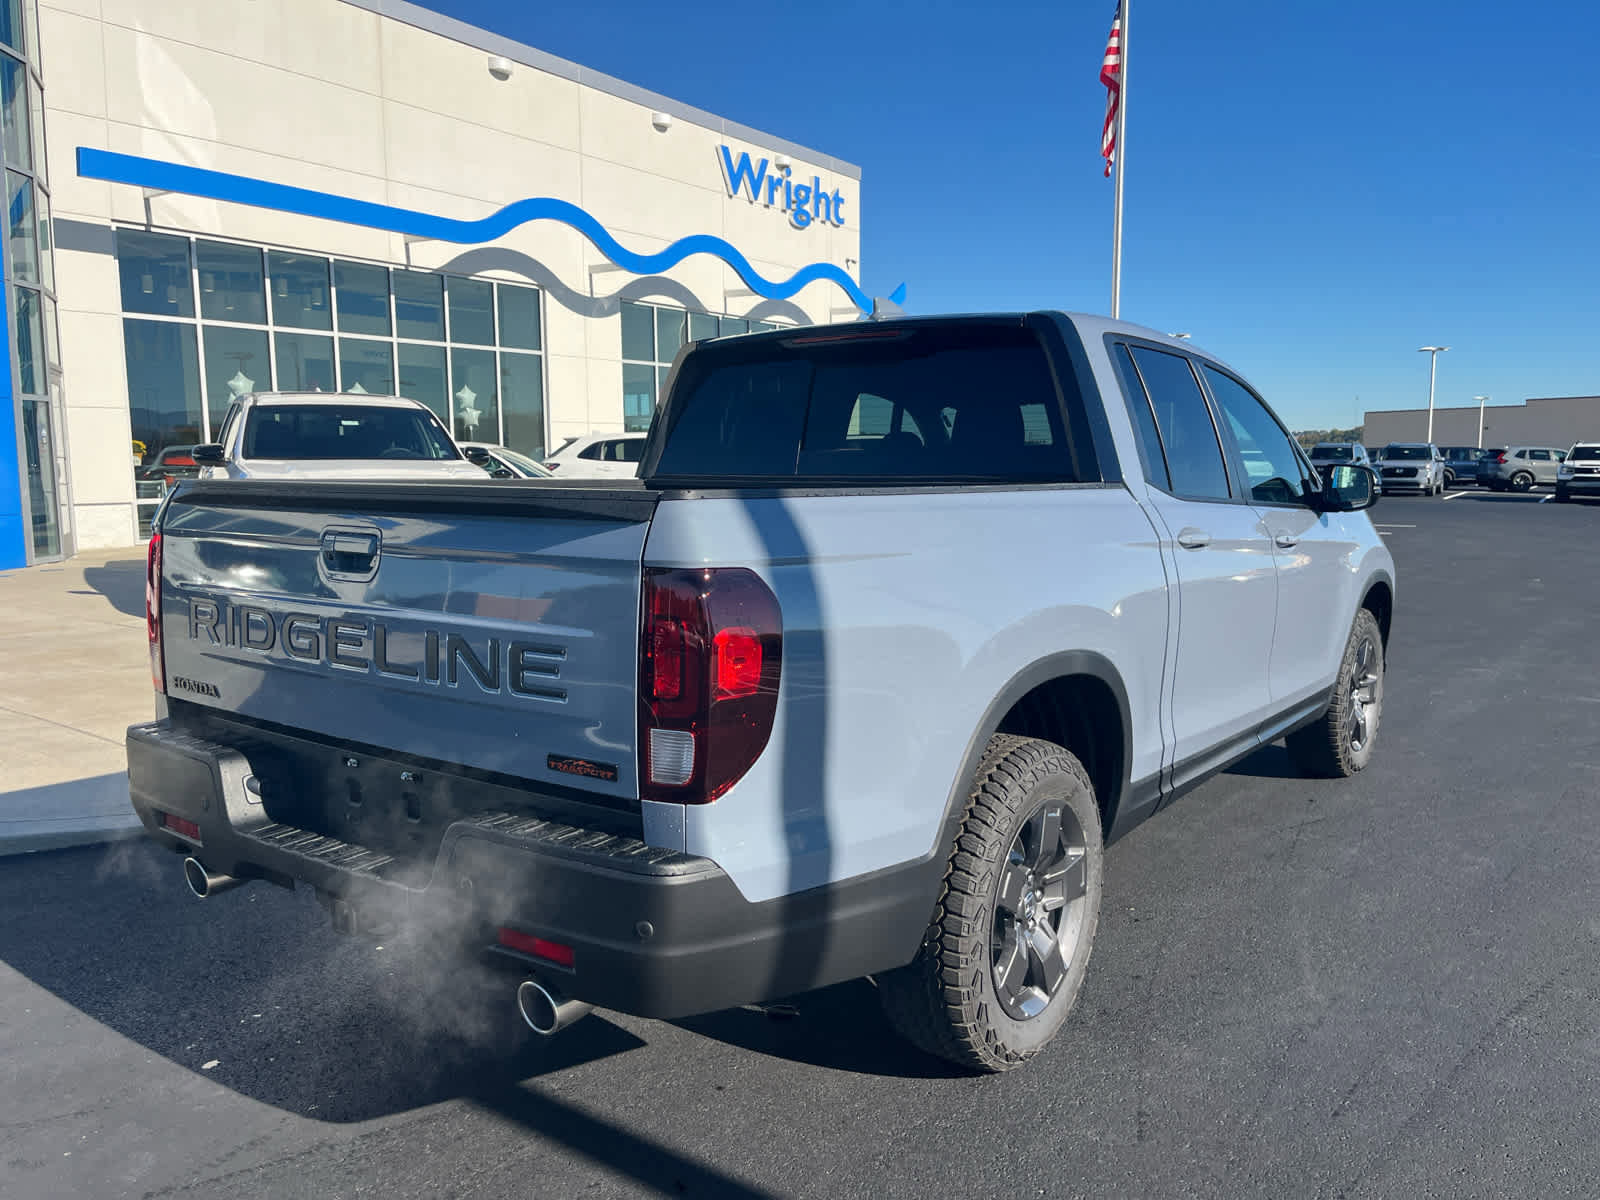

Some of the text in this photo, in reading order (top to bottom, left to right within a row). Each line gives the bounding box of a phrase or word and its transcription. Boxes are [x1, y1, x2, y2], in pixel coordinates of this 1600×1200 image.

[719, 144, 845, 228] Wright
[173, 676, 221, 698] HONDA
[188, 598, 569, 704] RIDGELINE
